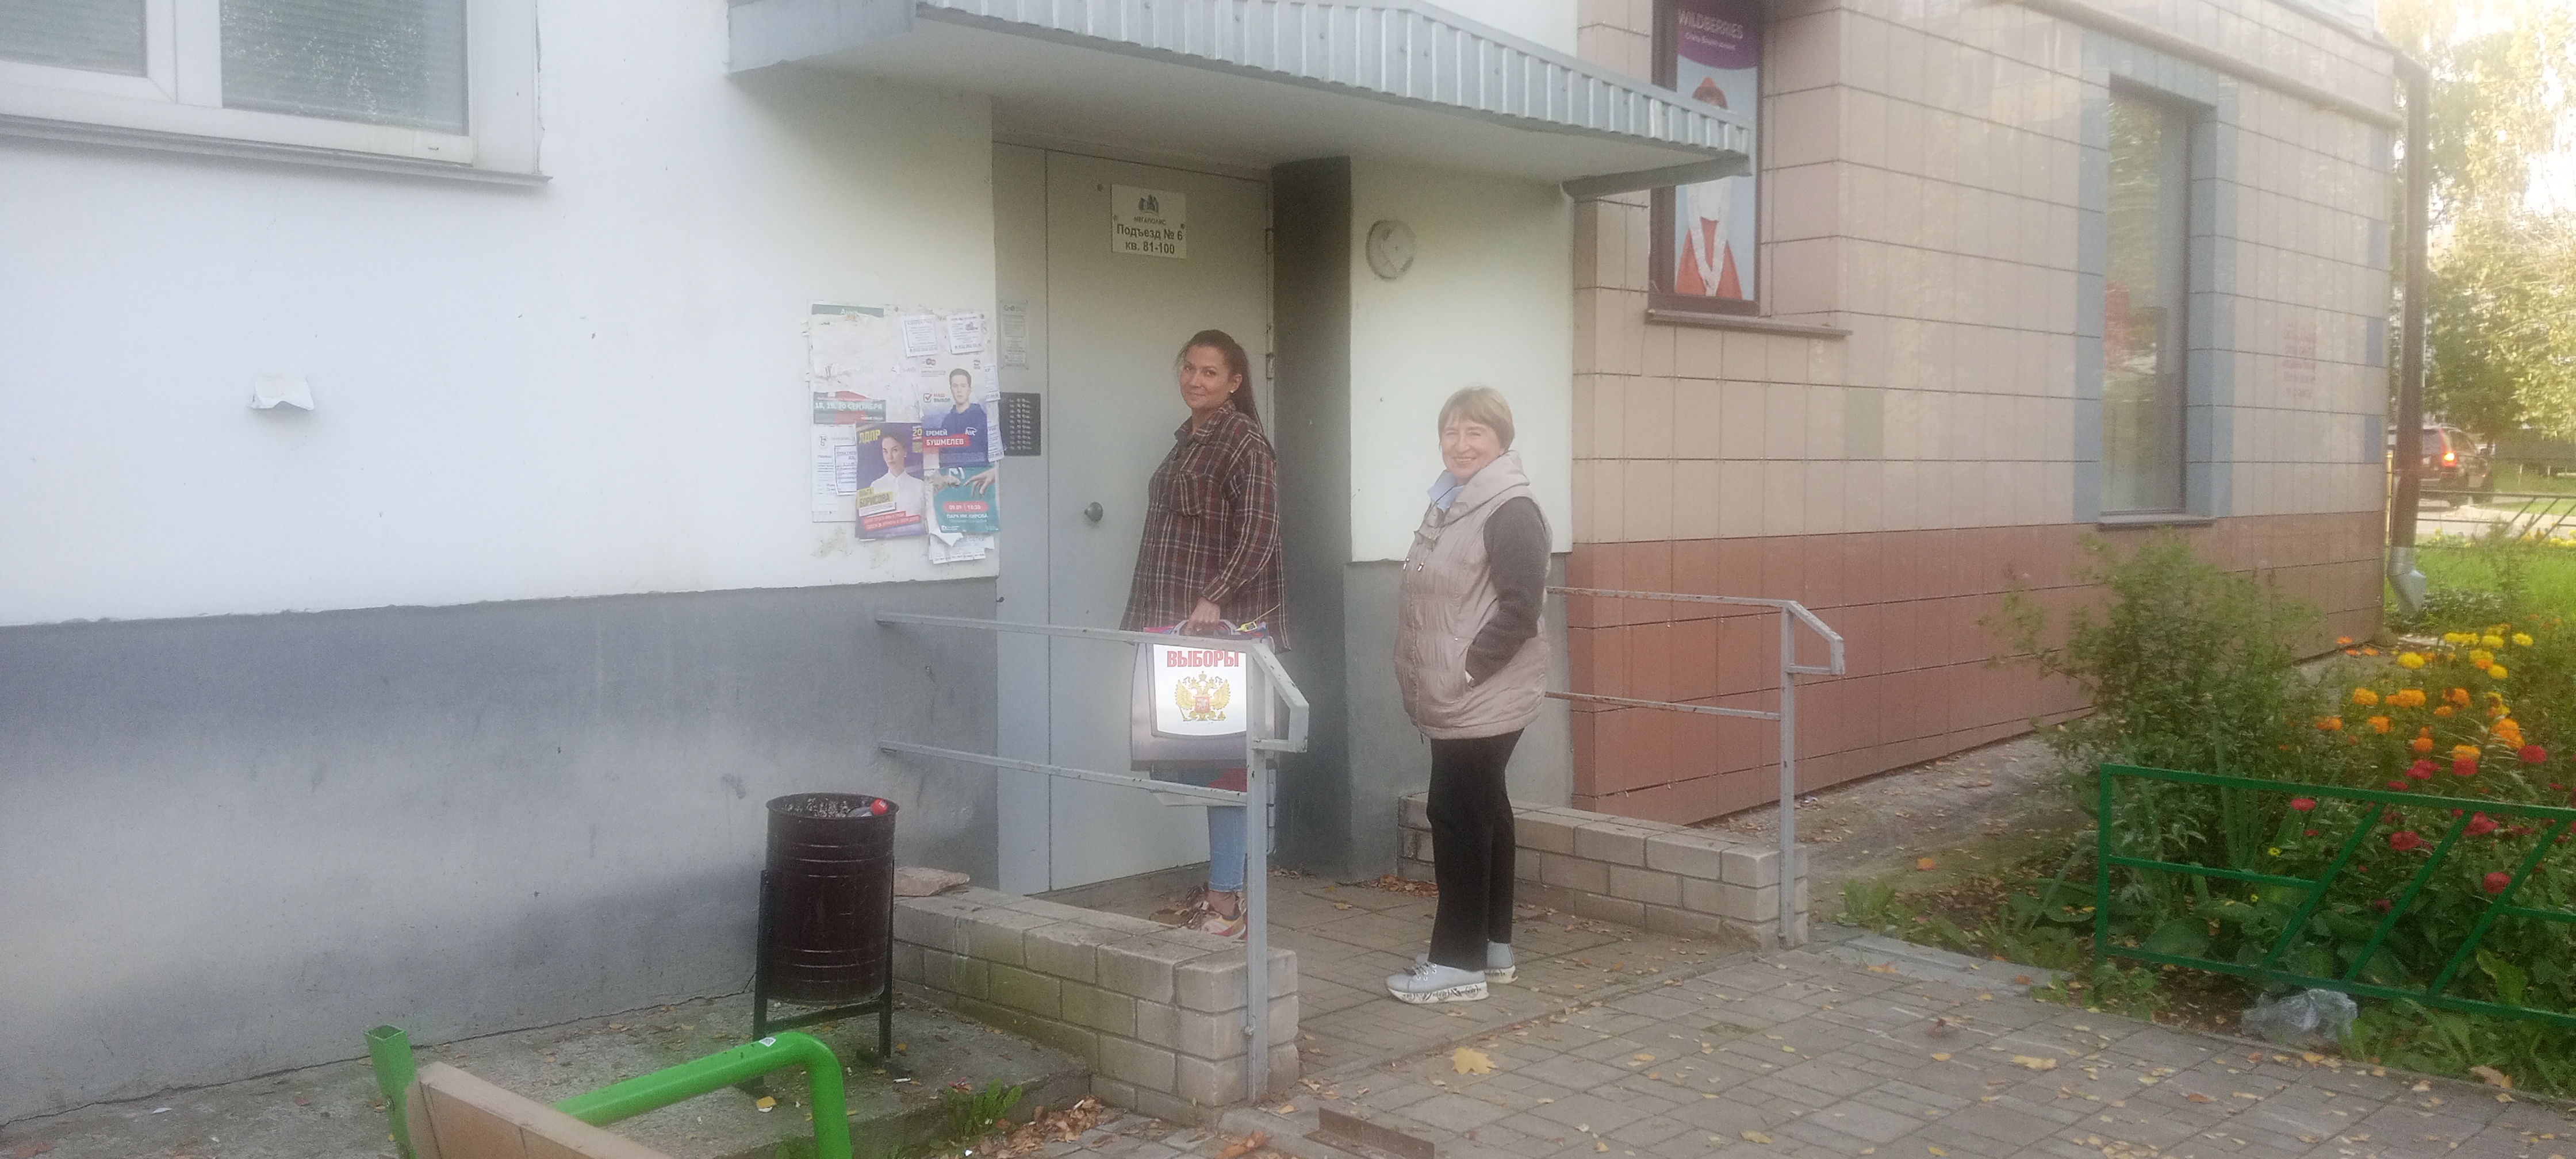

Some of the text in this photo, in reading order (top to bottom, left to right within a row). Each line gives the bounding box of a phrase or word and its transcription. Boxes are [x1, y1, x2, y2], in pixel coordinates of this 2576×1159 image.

[1678, 9, 1744, 40] WILDBERRIES
[1117, 224, 1183, 241] Подъезд № 6
[1125, 241, 1175, 254] кв. 81-100
[859, 429, 881, 444] ЛДПР
[913, 428, 922, 437] 20
[860, 493, 891, 508] БОРИСОВА
[1167, 650, 1239, 667] ВЫБОРЫ
